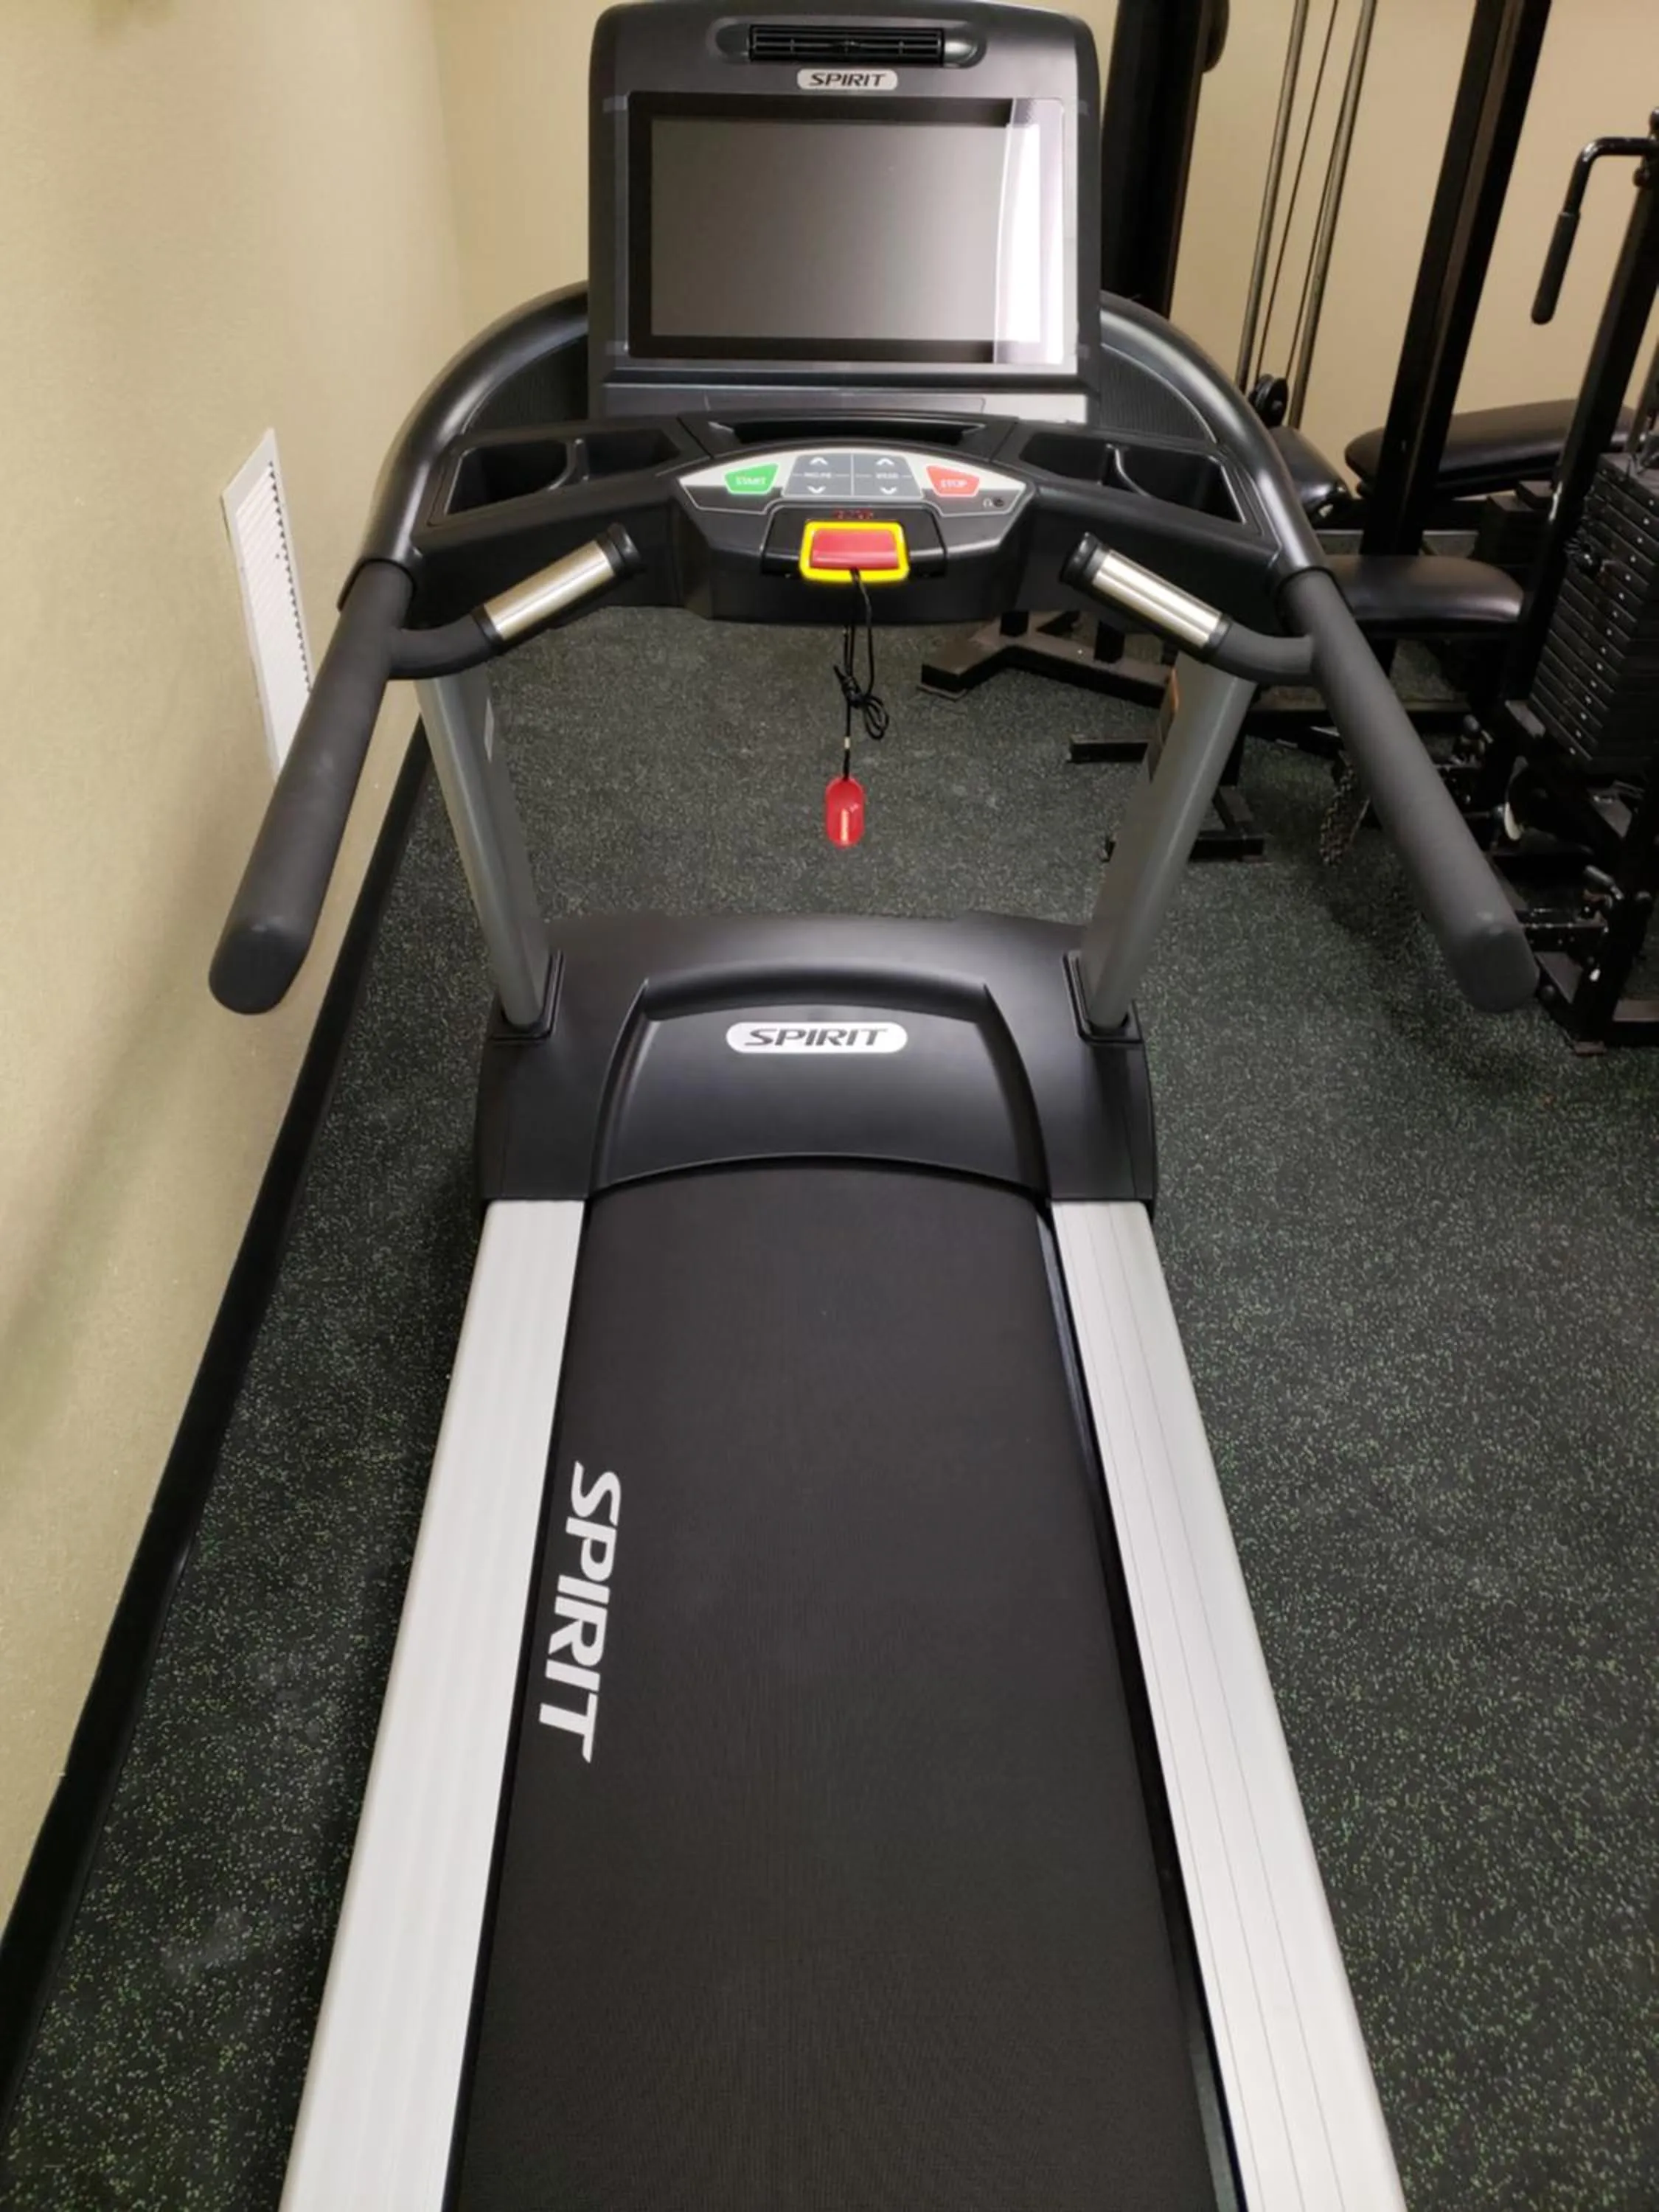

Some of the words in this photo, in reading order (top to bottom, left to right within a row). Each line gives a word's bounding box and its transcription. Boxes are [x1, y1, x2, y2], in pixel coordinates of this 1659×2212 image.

[809, 72, 886, 87] SPIRIT
[736, 476, 767, 485] START
[940, 479, 968, 487] STOP
[744, 1028, 888, 1046] SPIRIT
[538, 1461, 622, 1763] SPIRIT
